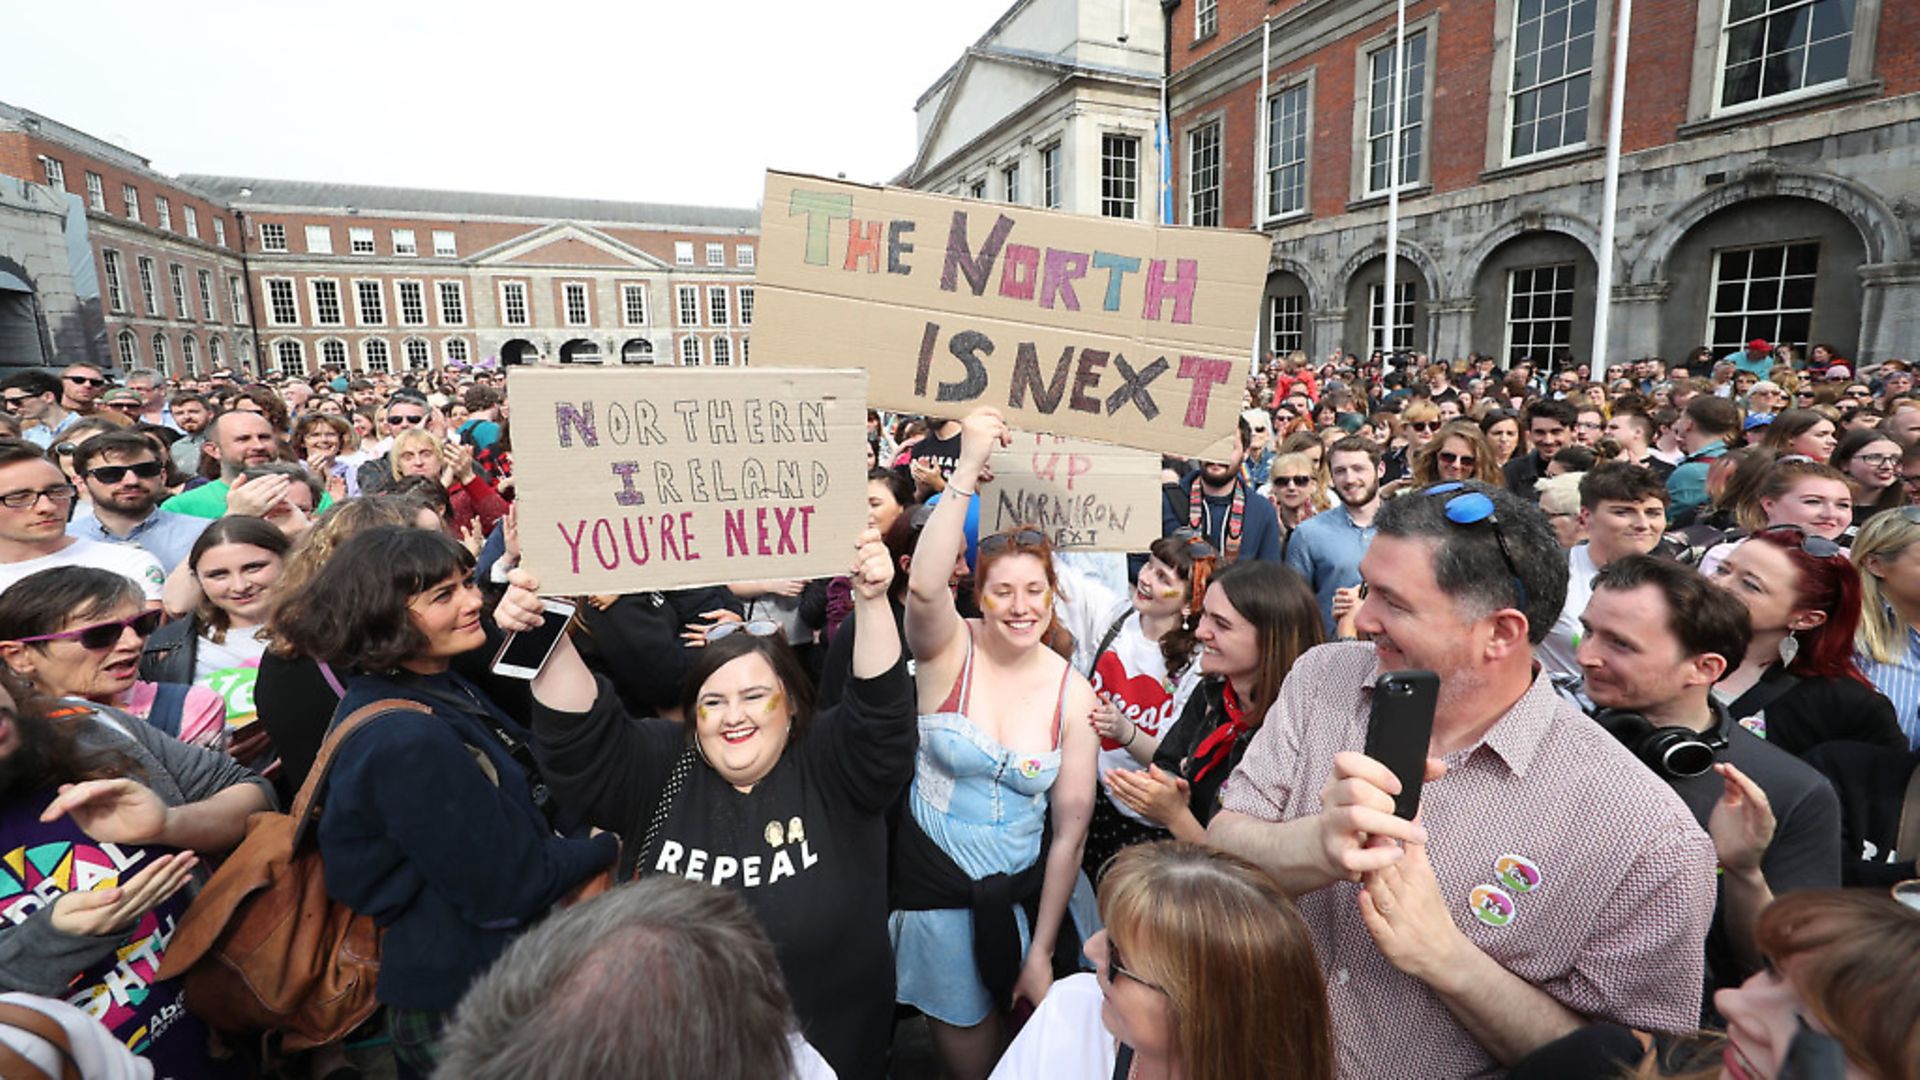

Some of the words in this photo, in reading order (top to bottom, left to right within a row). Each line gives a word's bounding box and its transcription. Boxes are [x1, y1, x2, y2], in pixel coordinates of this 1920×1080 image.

[788, 188, 917, 276] THE
[940, 210, 1199, 325] NORTH
[914, 321, 995, 402] IS
[1007, 342, 1232, 429] NEXT
[555, 398, 829, 448] NORTHERN
[611, 457, 830, 506] IRELAND
[557, 511, 701, 574] YOU'RE
[724, 505, 815, 558] NEXT
[655, 839, 819, 887] REPEAL
